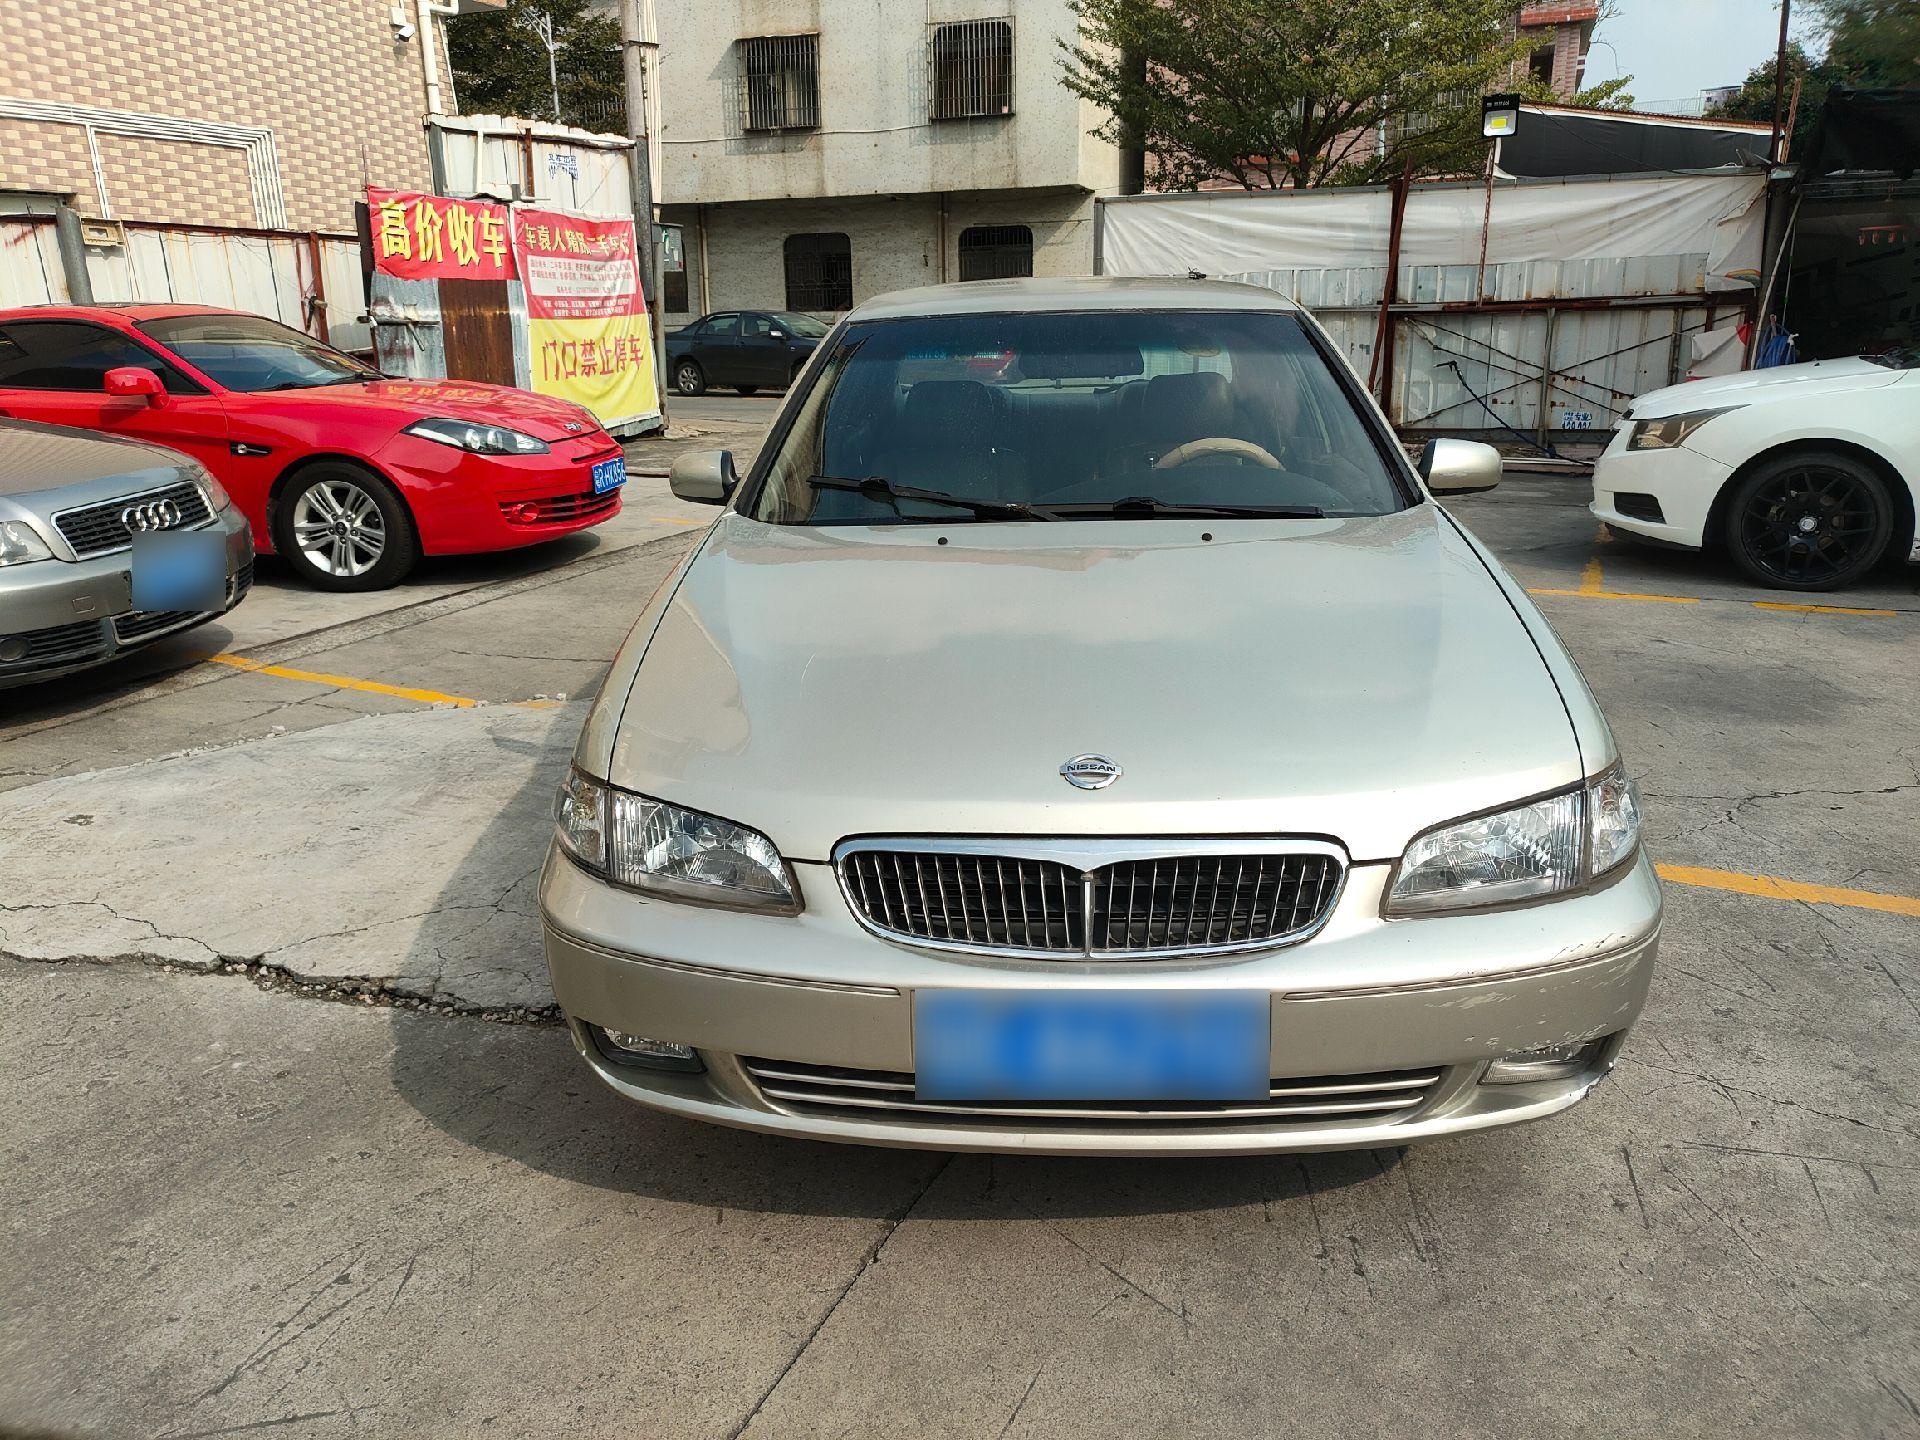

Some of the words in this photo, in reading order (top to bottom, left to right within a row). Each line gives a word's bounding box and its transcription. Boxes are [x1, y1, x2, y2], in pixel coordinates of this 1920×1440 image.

[378, 197, 508, 268] 高价收车
[542, 334, 643, 381] 门口禁止停车
[1067, 763, 1116, 772] NISSAN
